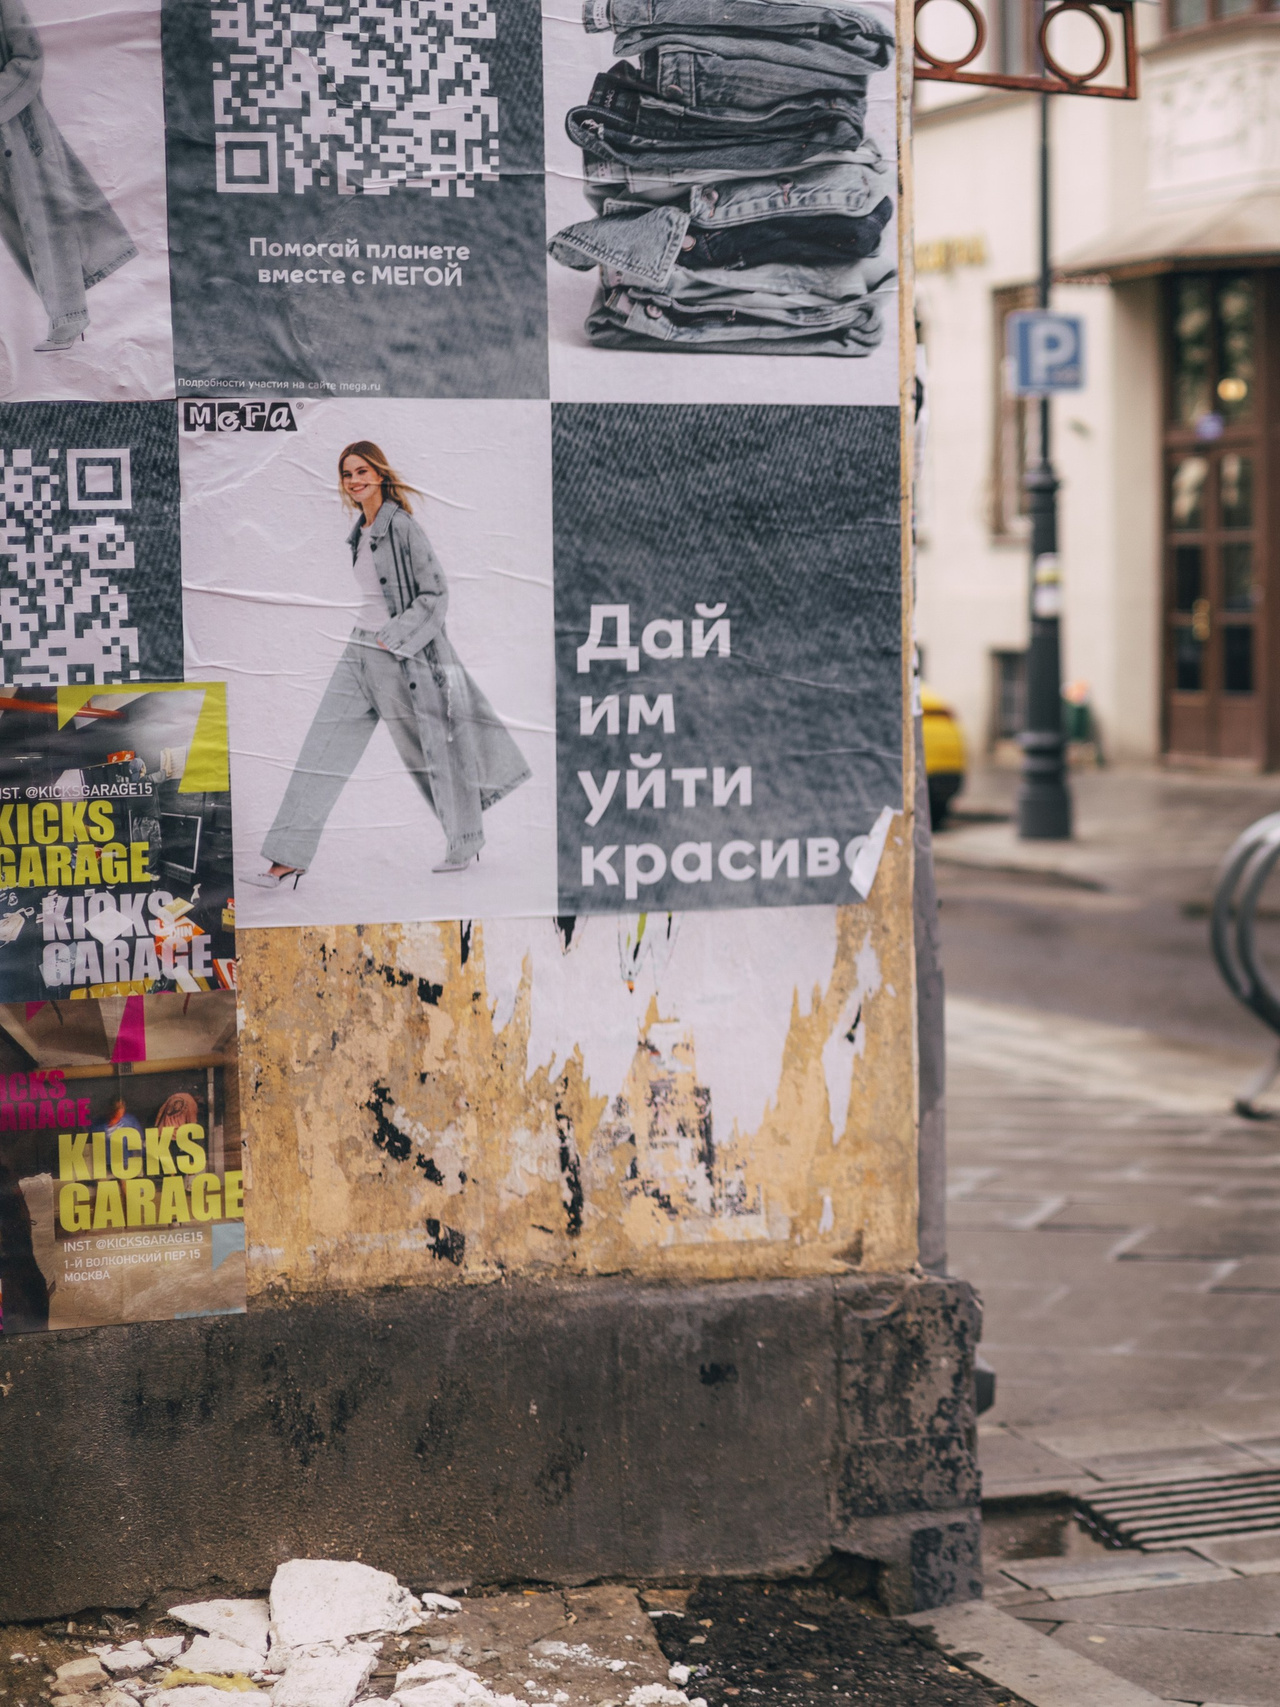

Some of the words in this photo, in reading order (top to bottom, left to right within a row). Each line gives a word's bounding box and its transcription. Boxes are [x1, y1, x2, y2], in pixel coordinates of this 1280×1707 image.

[249, 237, 360, 258] Помогай
[366, 244, 471, 261] планете
[258, 268, 346, 285] вместе
[351, 269, 366, 285] с
[371, 262, 463, 287] МЕГОЙ
[177, 378, 245, 389] Подробности
[248, 380, 289, 390] участия
[292, 381, 305, 390] на
[307, 380, 337, 391] сайте
[339, 381, 381, 393] mega.ru
[577, 602, 731, 673] Дай
[579, 693, 676, 735] им
[0, 787, 22, 800] ST.
[25, 782, 153, 800] @KICKSGARAGE15
[577, 752, 752, 828] уйти
[0, 841, 151, 889] GARAGE
[42, 934, 213, 987] GARAGE
[58, 1123, 206, 1182] KICKS
[59, 1170, 244, 1232] GARAGE
[63, 1240, 93, 1253] INST.
[95, 1231, 203, 1251] @KICKSGARAGE15
[64, 1256, 83, 1270] 1-Й
[85, 1250, 161, 1268] ВОЛКОНСКИЙ
[64, 1270, 111, 1283] МОСКВА
